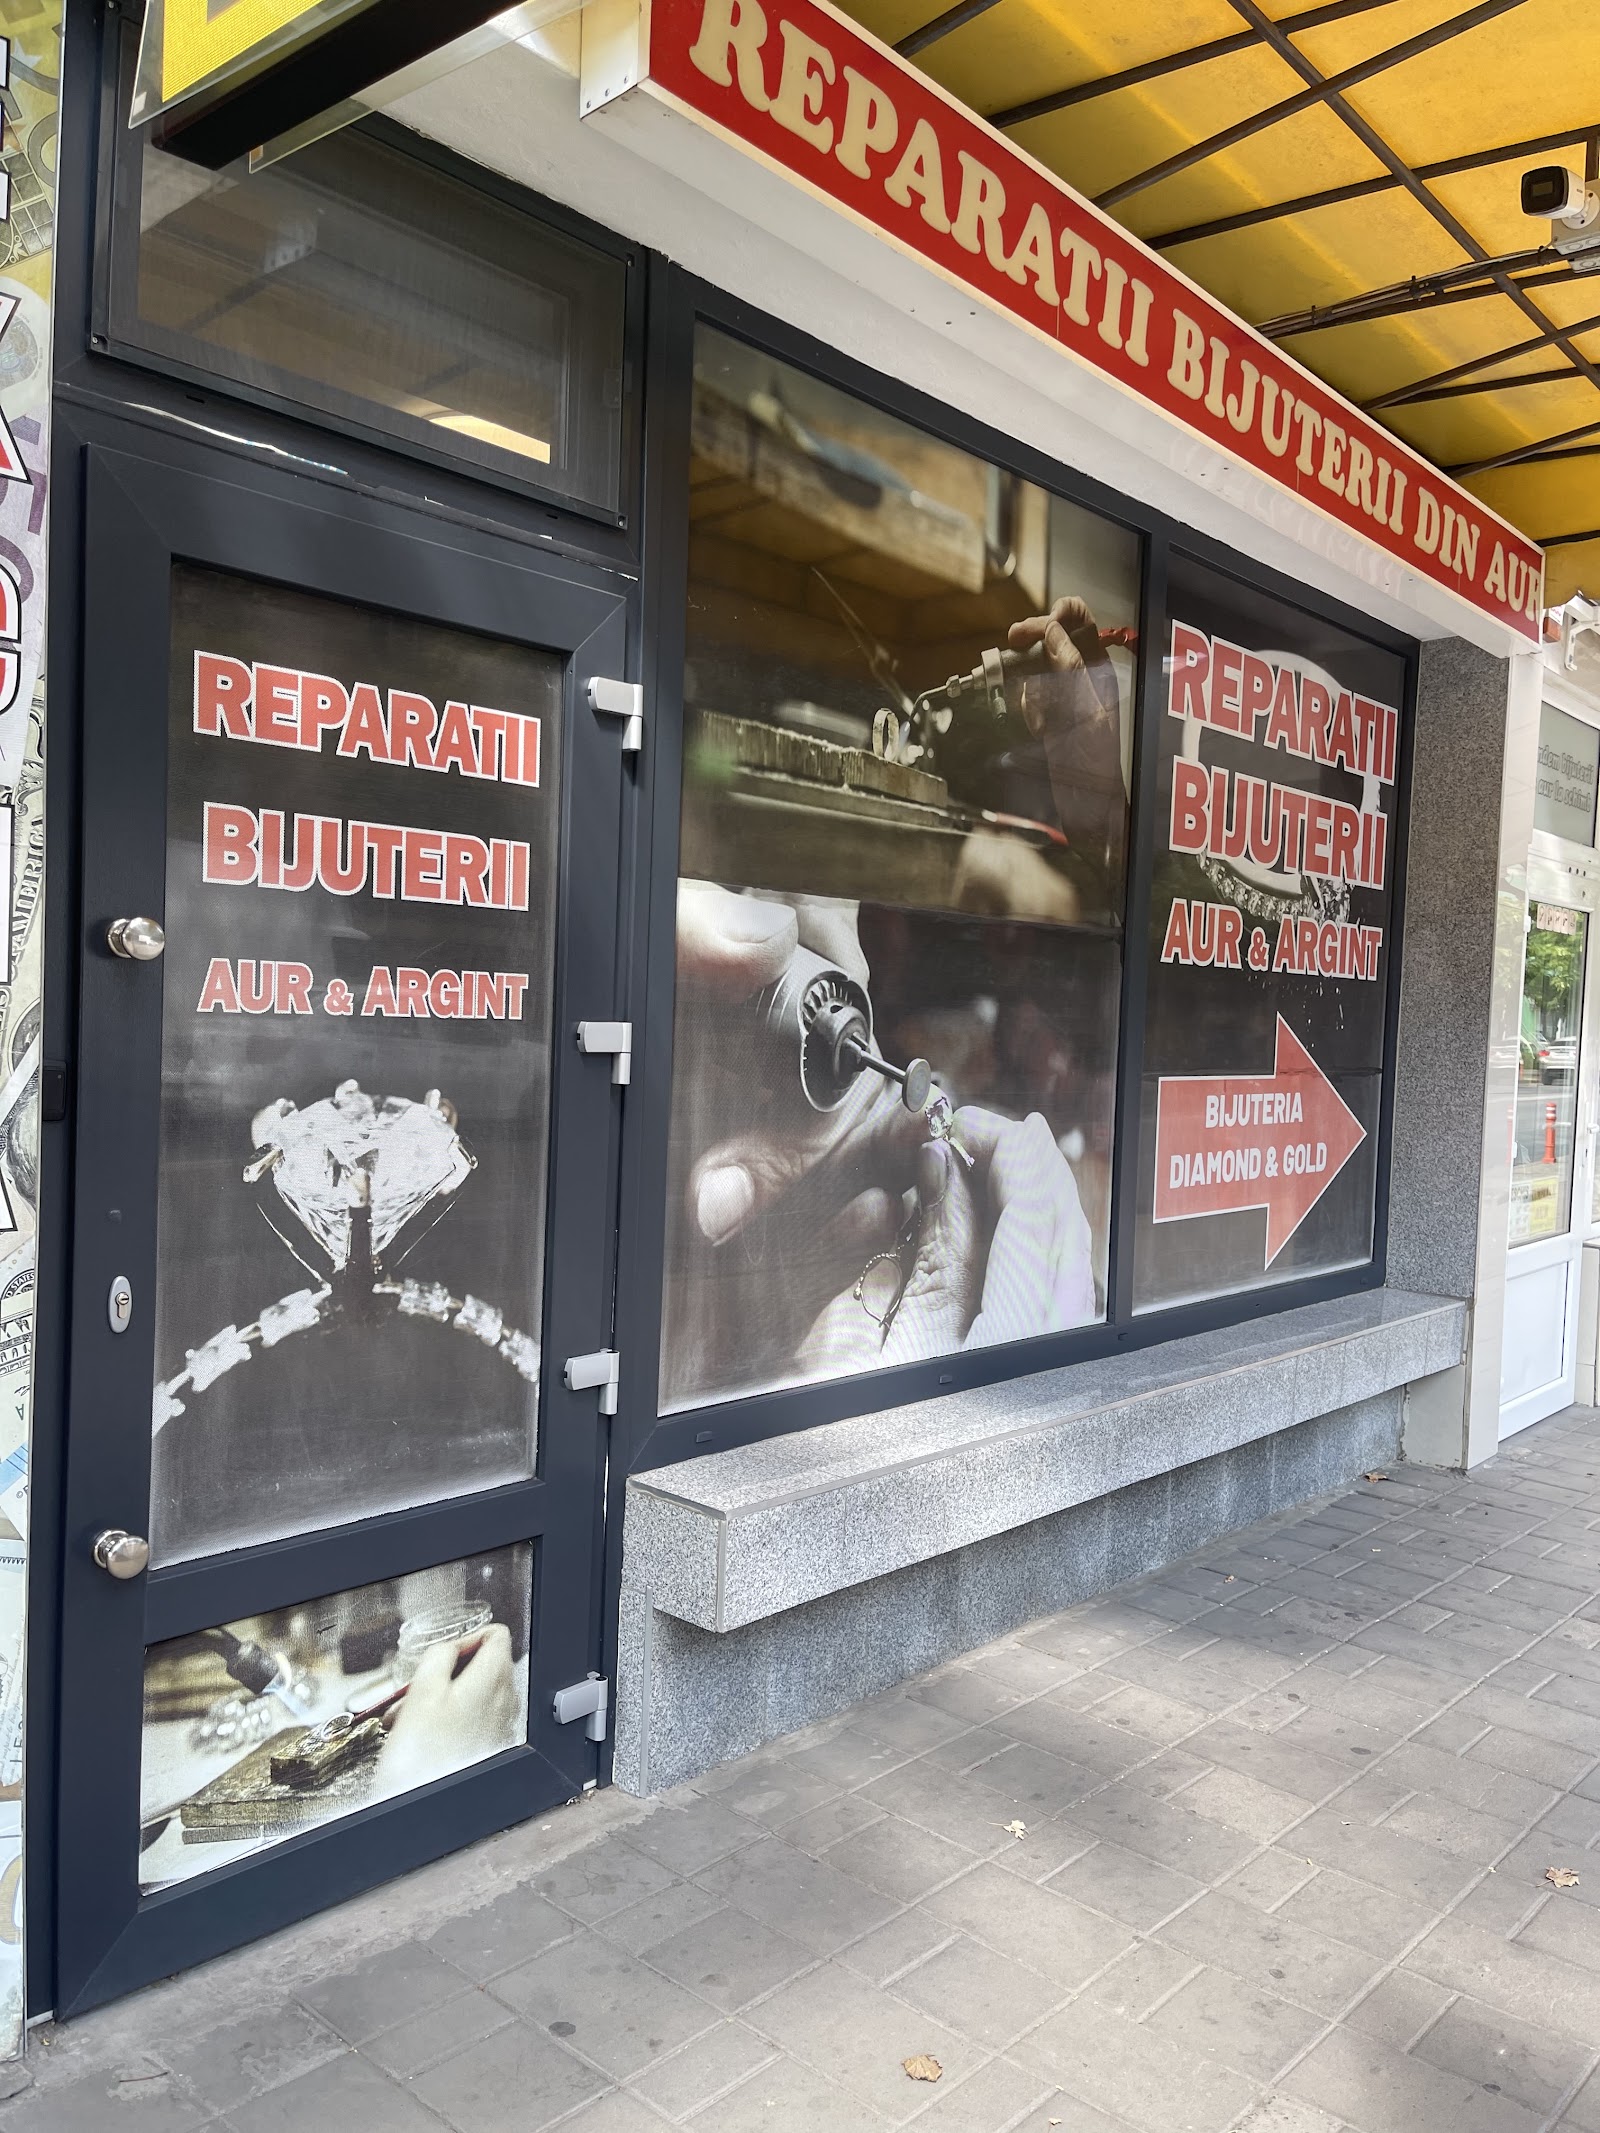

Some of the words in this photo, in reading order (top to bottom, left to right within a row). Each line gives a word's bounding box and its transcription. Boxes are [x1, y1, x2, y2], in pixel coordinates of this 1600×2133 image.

[690, 0, 1154, 367] REPARATII
[1167, 308, 1409, 536] BIJUTERII
[1413, 486, 1481, 581] DIN
[1483, 540, 1541, 626] AUR
[193, 649, 541, 788] REPARATII
[1168, 619, 1398, 786] REPARATII
[203, 801, 530, 911] BIJUTERII
[1169, 754, 1388, 891] BIJUTERII
[196, 958, 313, 1015] AUR
[323, 978, 354, 1015] &
[360, 965, 529, 1020] ARGINT
[1160, 897, 1243, 969] AUR
[1249, 926, 1269, 971] &
[1272, 914, 1383, 981] ARGINT
[1170, 1147, 1261, 1189] DIAMOND
[1265, 1146, 1278, 1178] &
[1283, 1142, 1327, 1176] GOLD
[1205, 1093, 1303, 1128] BIJUTERIA
